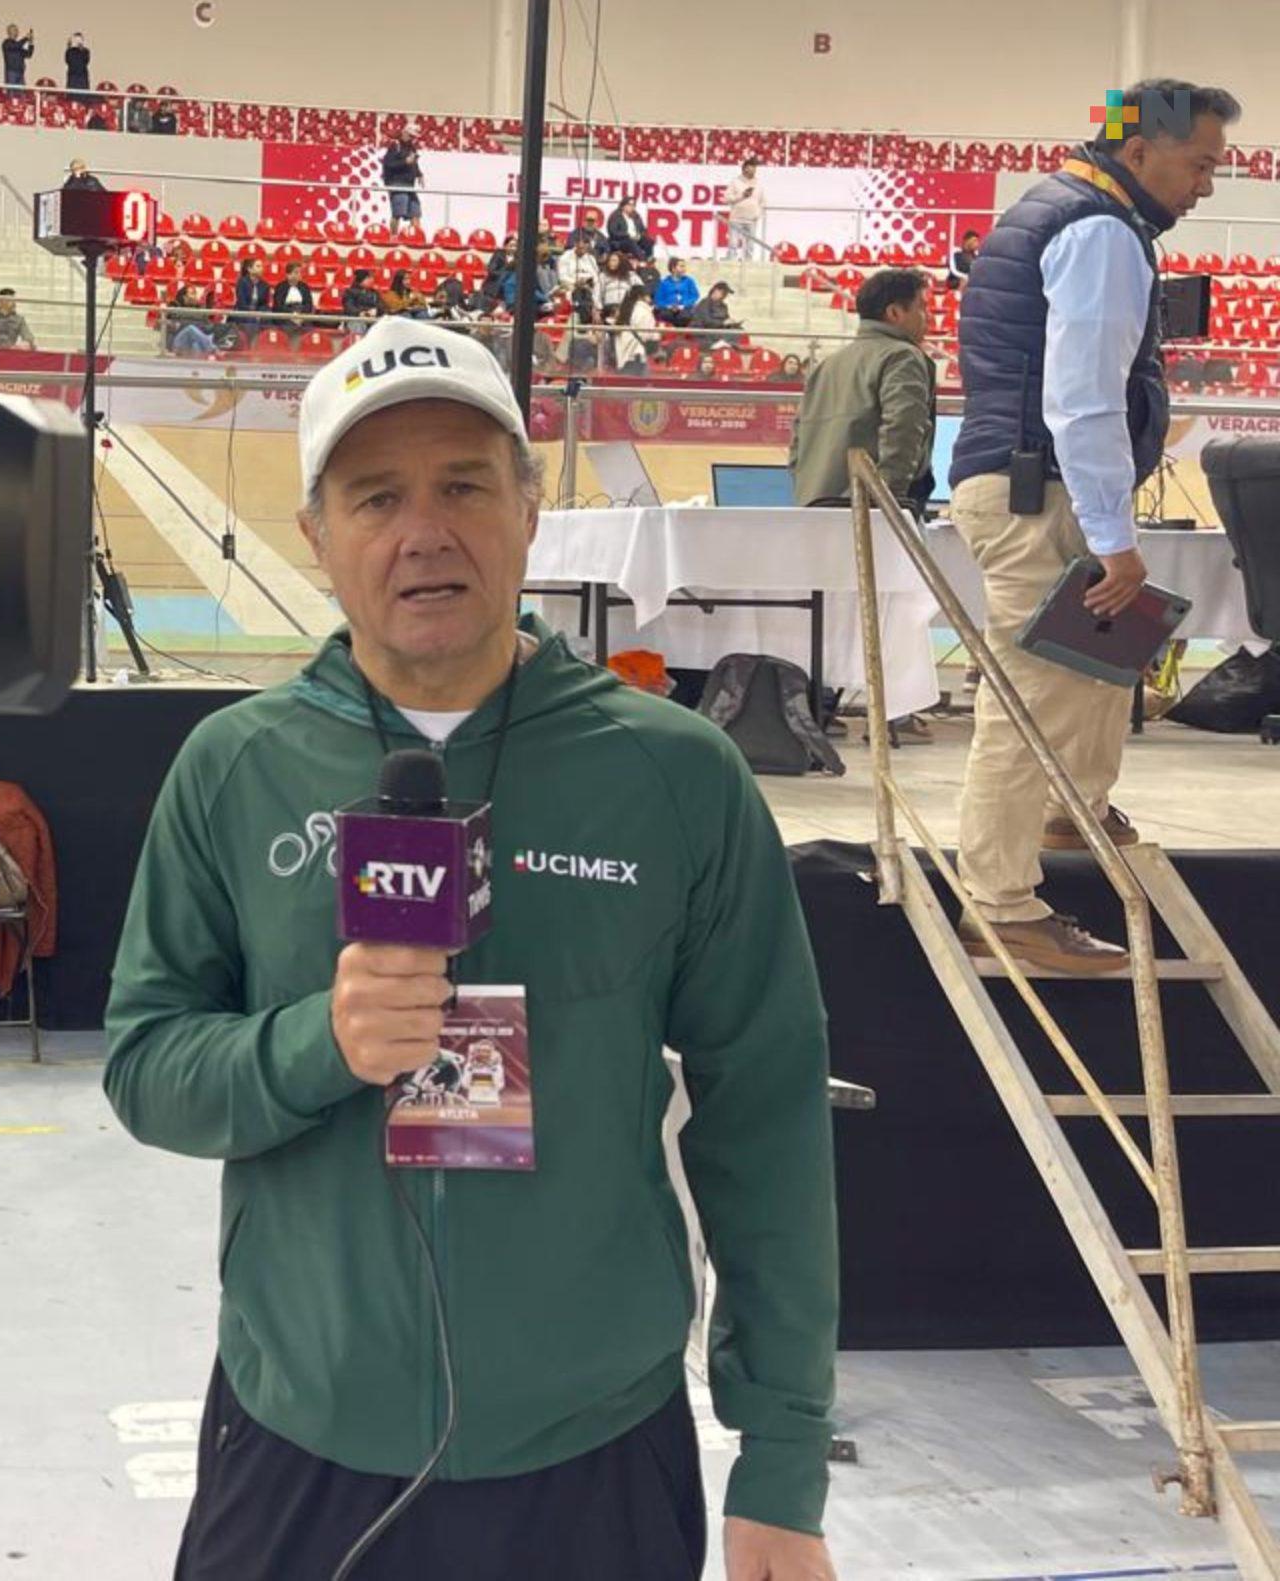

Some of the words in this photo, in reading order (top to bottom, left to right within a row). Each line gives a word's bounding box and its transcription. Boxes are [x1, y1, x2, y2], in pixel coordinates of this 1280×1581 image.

[195, 2, 212, 23] C
[813, 33, 831, 54] B
[566, 176, 683, 205] FUTURO
[692, 184, 729, 206] DE
[361, 345, 451, 378] UCI
[679, 405, 756, 419] VERACRUZ
[366, 861, 448, 898] RTV
[526, 850, 639, 885] UCIMEX
